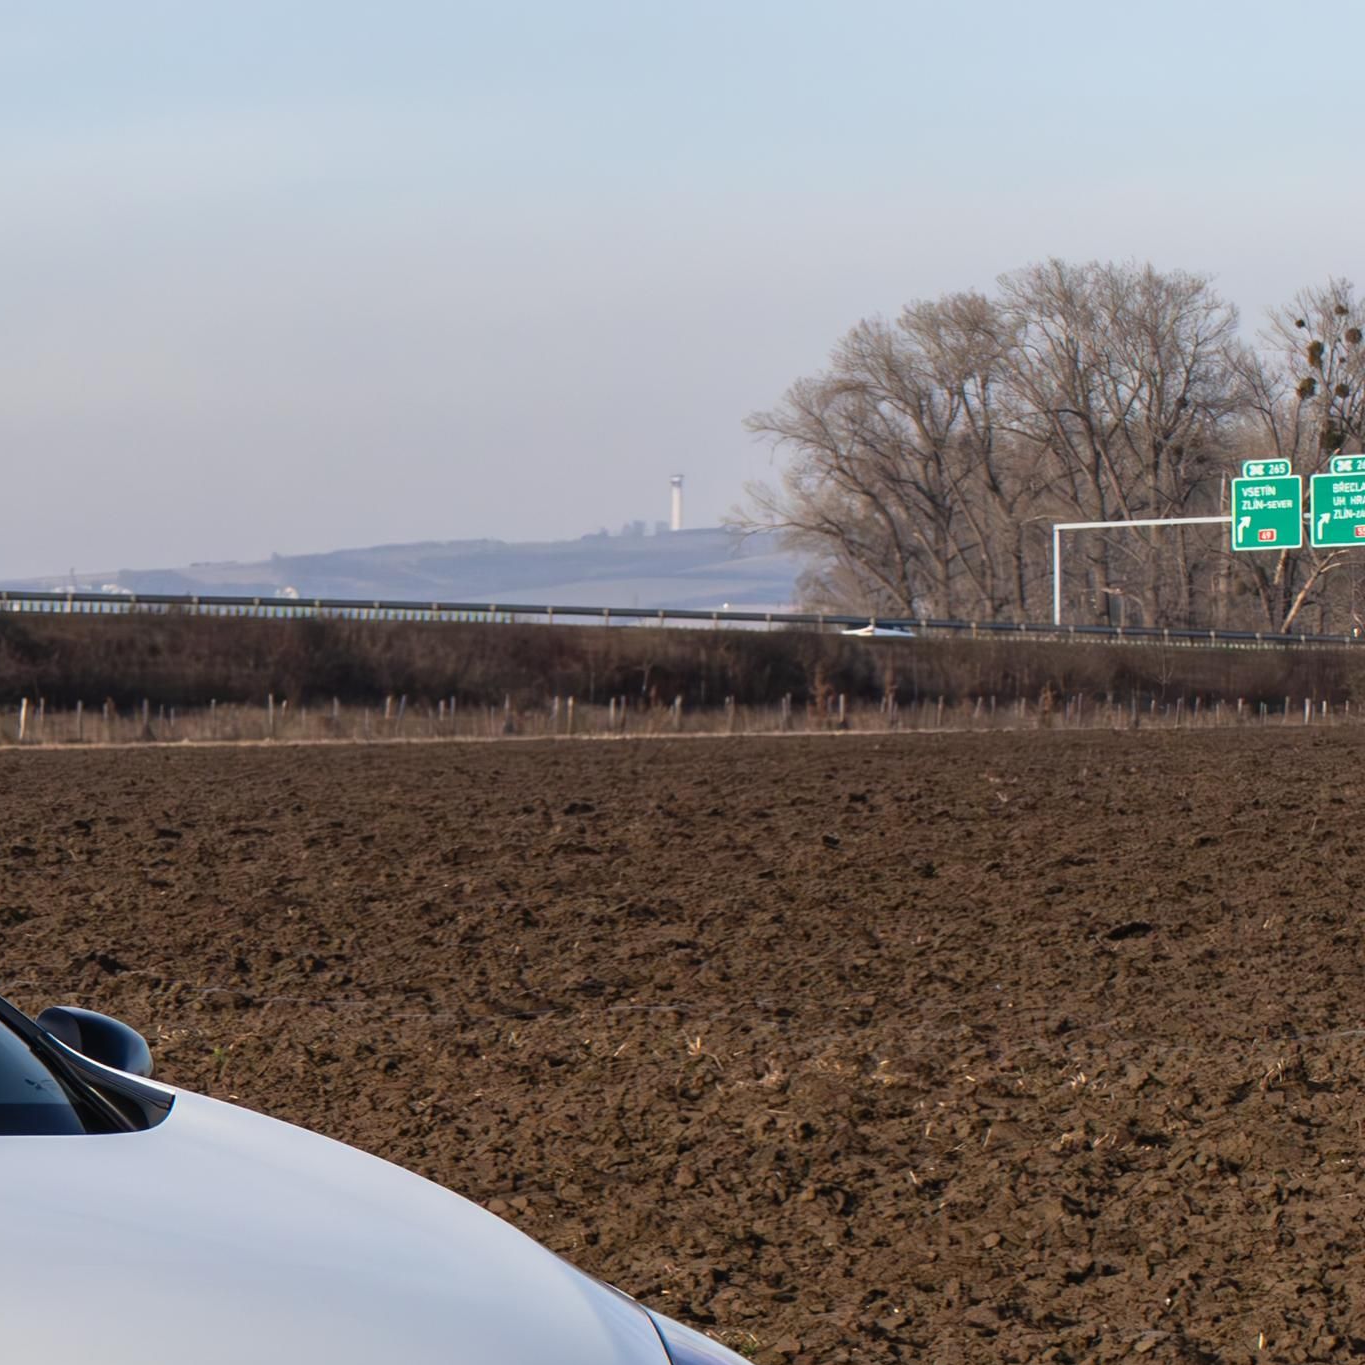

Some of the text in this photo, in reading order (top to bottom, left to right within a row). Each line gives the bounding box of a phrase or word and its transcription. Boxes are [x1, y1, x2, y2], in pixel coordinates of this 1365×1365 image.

[1268, 463, 1286, 475] 265
[1241, 485, 1277, 497] VSETÍN
[1241, 498, 1293, 511] ZLÍN-SEVER
